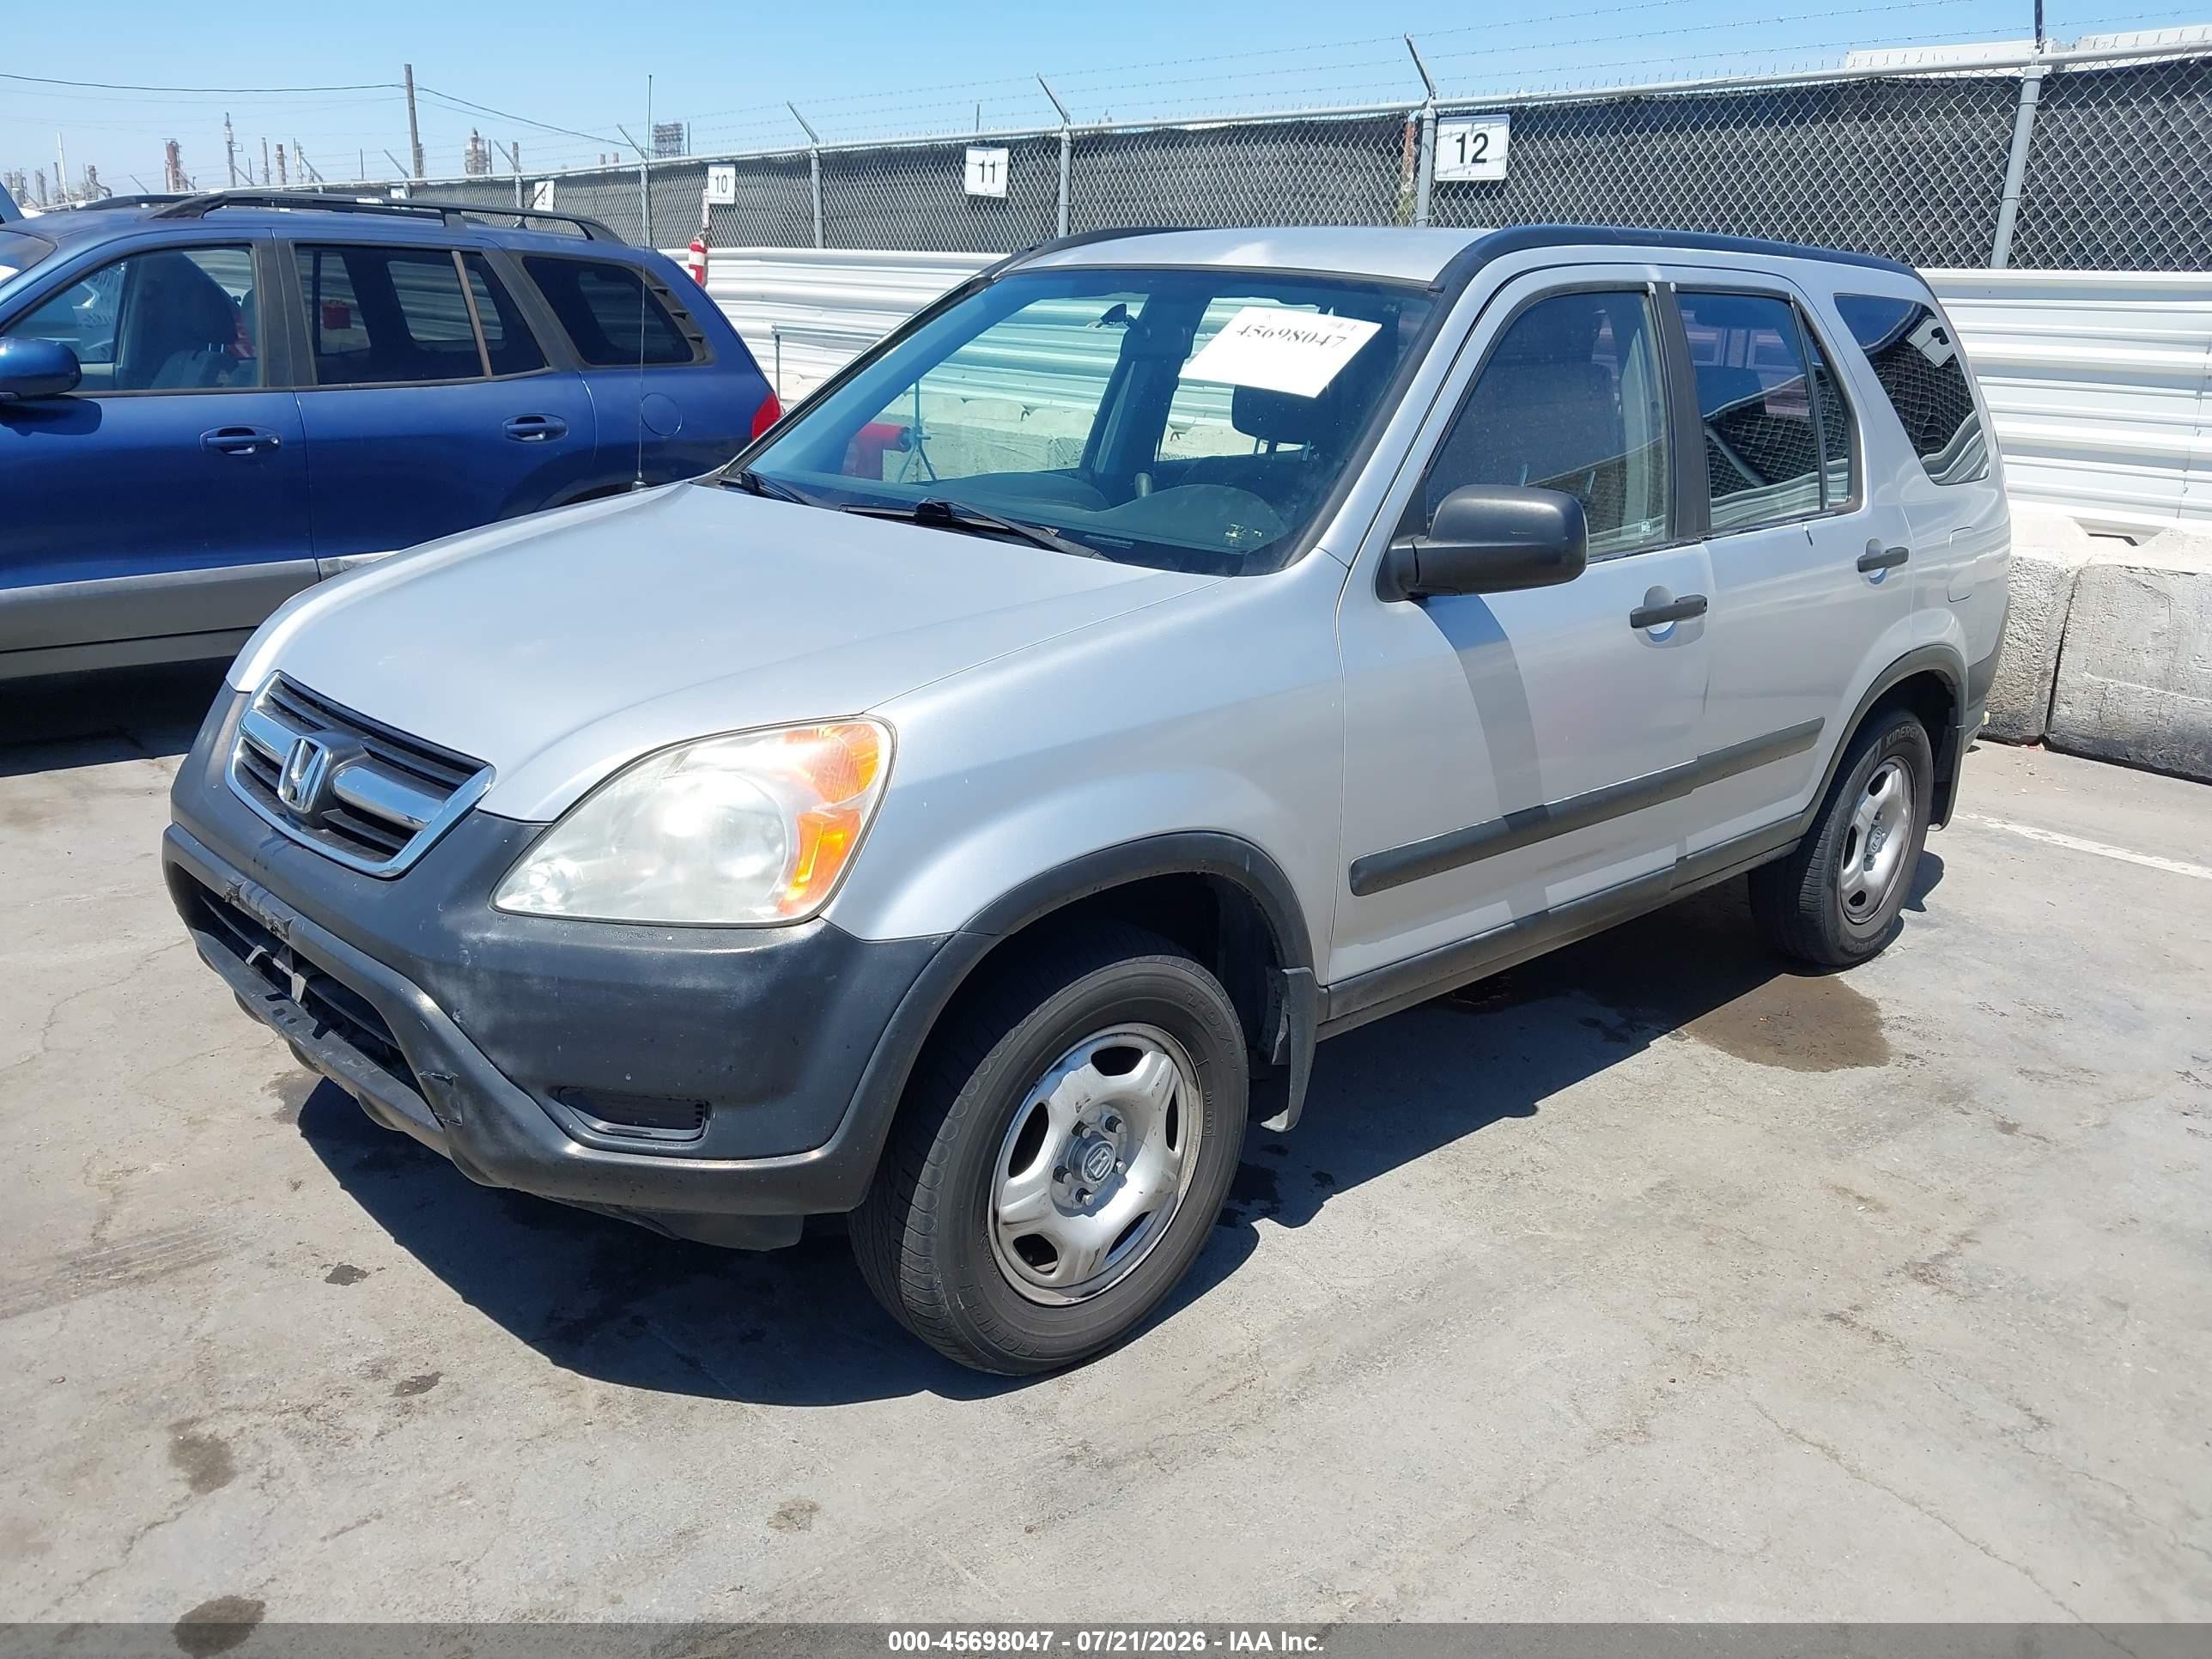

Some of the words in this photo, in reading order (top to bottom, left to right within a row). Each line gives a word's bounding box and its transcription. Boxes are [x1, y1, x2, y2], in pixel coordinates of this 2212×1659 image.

[1455, 131, 1489, 164] 12
[715, 174, 728, 193] 10
[978, 159, 996, 184] 11
[1237, 324, 1347, 349] 45698047
